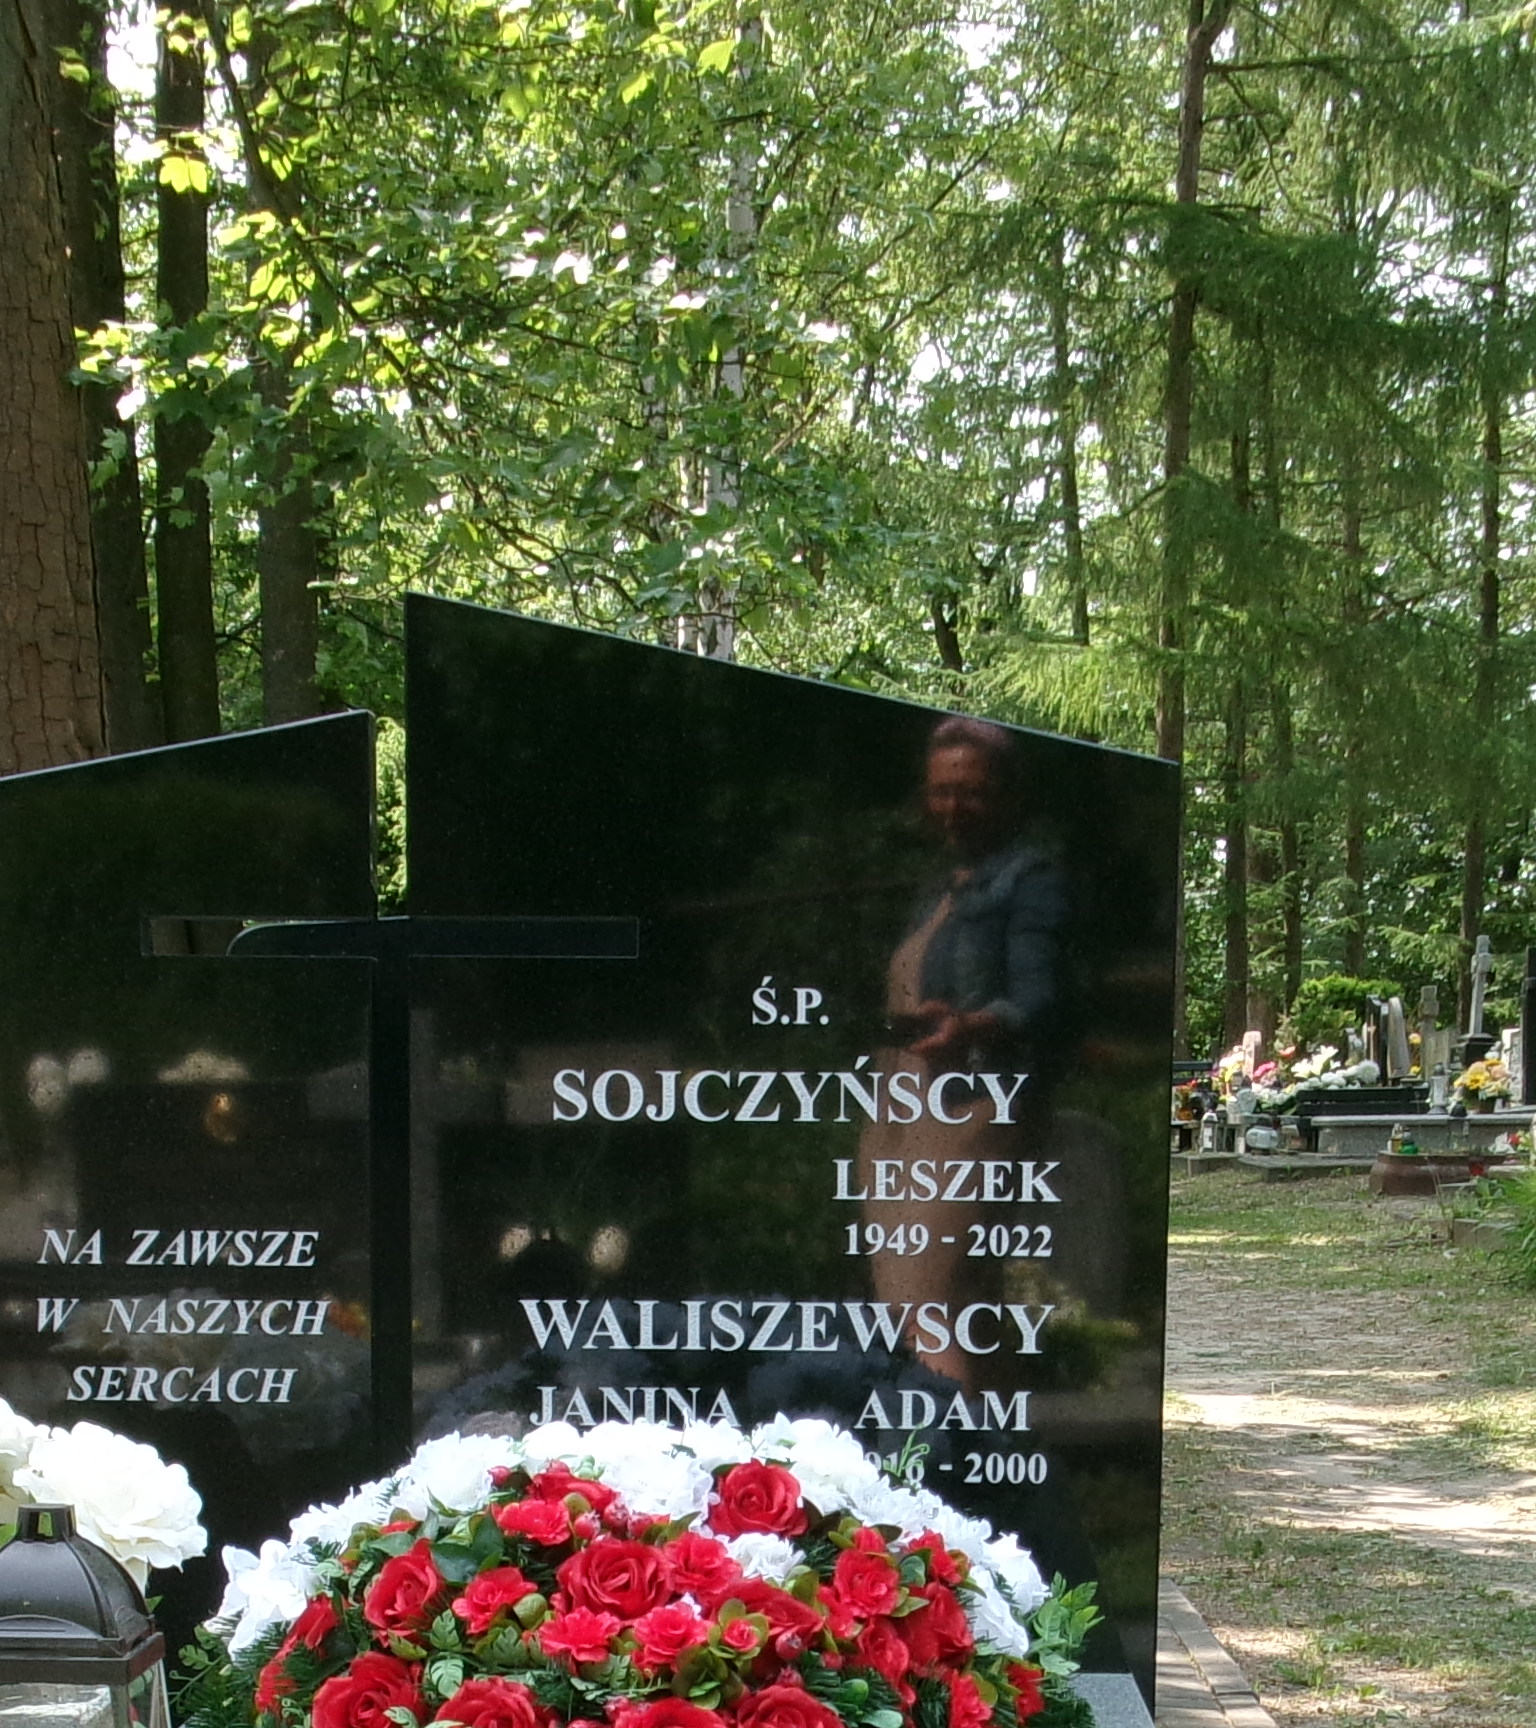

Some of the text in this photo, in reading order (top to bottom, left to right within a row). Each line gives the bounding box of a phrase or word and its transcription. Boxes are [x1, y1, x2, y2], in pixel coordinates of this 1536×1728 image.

[751, 977, 830, 1026] Ś.P.
[551, 1055, 1029, 1125] SOJCZYŃSCY
[831, 1160, 1062, 1203] LESZEK
[37, 1228, 320, 1267] NA ZAWSZE
[844, 1222, 930, 1257] 1949
[966, 1224, 1053, 1259] 2022
[36, 1297, 332, 1336] W NASZYCH
[518, 1299, 1058, 1355] WALISZEWSCY
[66, 1365, 299, 1404] SERCACH
[529, 1385, 1033, 1432] JANINA ADAM
[864, 1450, 926, 1484] 916
[963, 1452, 1048, 1485] 2000
